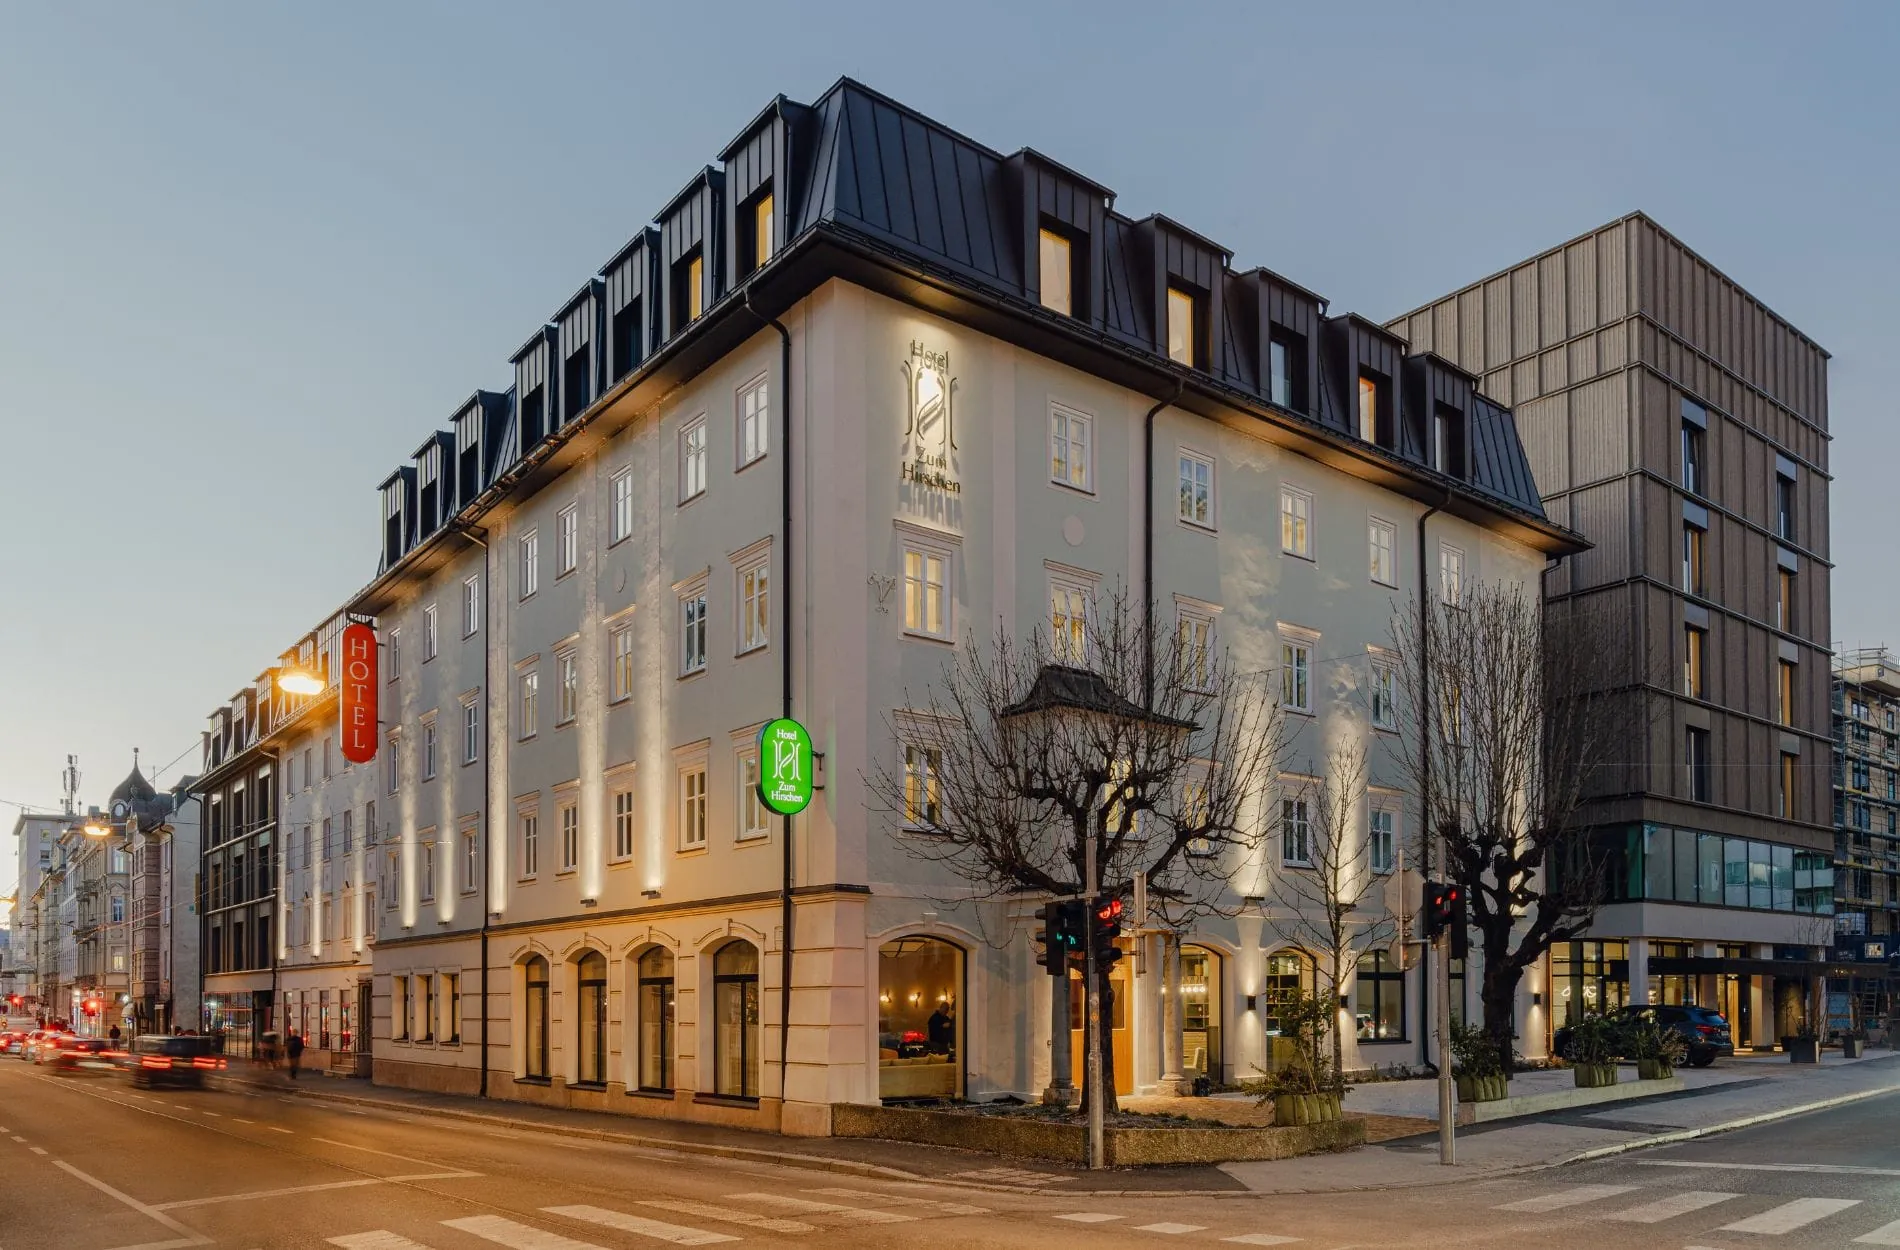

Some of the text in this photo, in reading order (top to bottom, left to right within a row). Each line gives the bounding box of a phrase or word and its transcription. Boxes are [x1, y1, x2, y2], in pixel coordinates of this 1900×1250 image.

[912, 339, 949, 369] Hotel
[916, 446, 947, 470] Zum
[902, 461, 960, 493] Hirschen
[349, 637, 369, 749] HOTEL
[776, 728, 797, 740] Hotel
[771, 790, 803, 803] Hirschen
[778, 781, 796, 792] Zum
